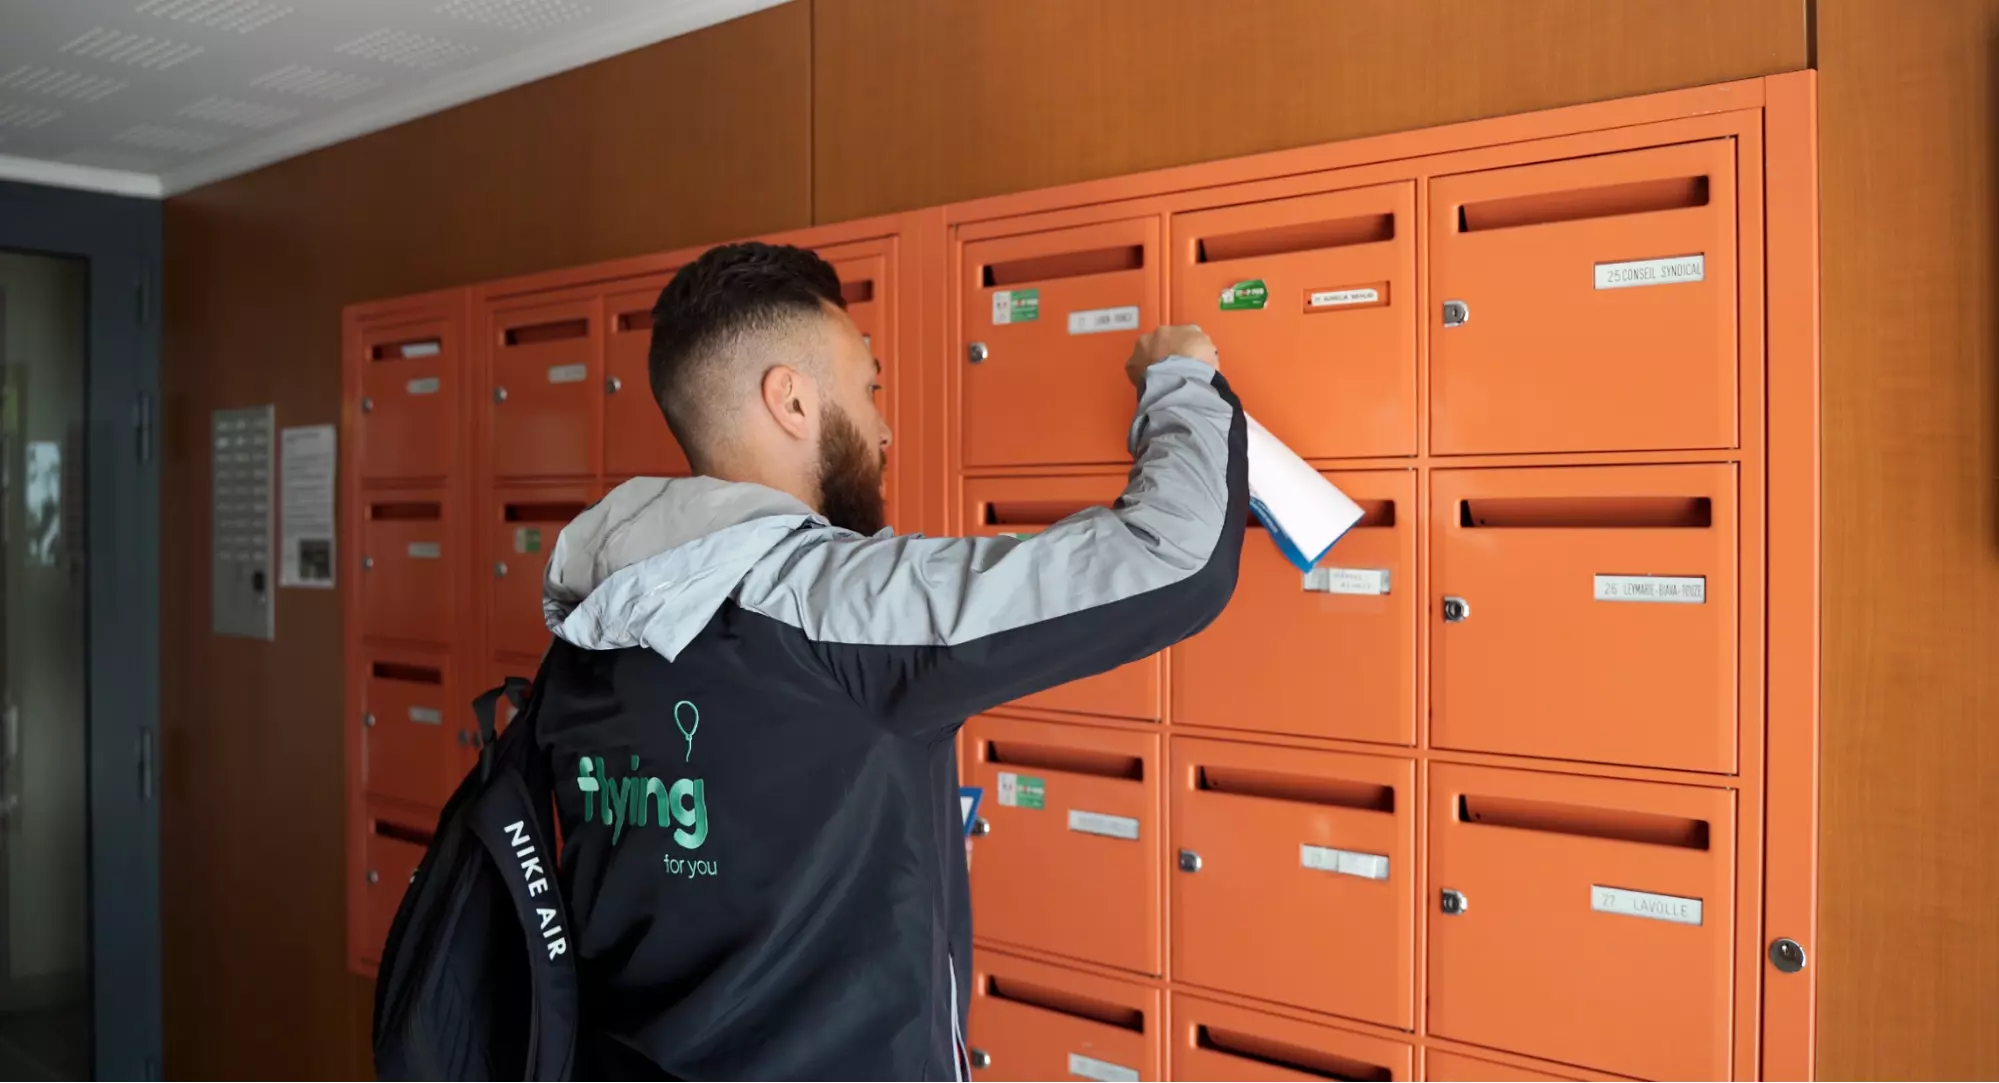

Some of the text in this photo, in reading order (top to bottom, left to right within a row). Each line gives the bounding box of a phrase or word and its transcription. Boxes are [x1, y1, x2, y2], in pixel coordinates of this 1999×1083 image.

[1661, 262, 1701, 278] SYNDICAL
[1604, 582, 1618, 595] 26
[577, 755, 708, 849] flying
[664, 854, 717, 879] for you
[504, 820, 567, 961] NIKE AIR
[1602, 894, 1689, 918] 27 LAVOLLE
